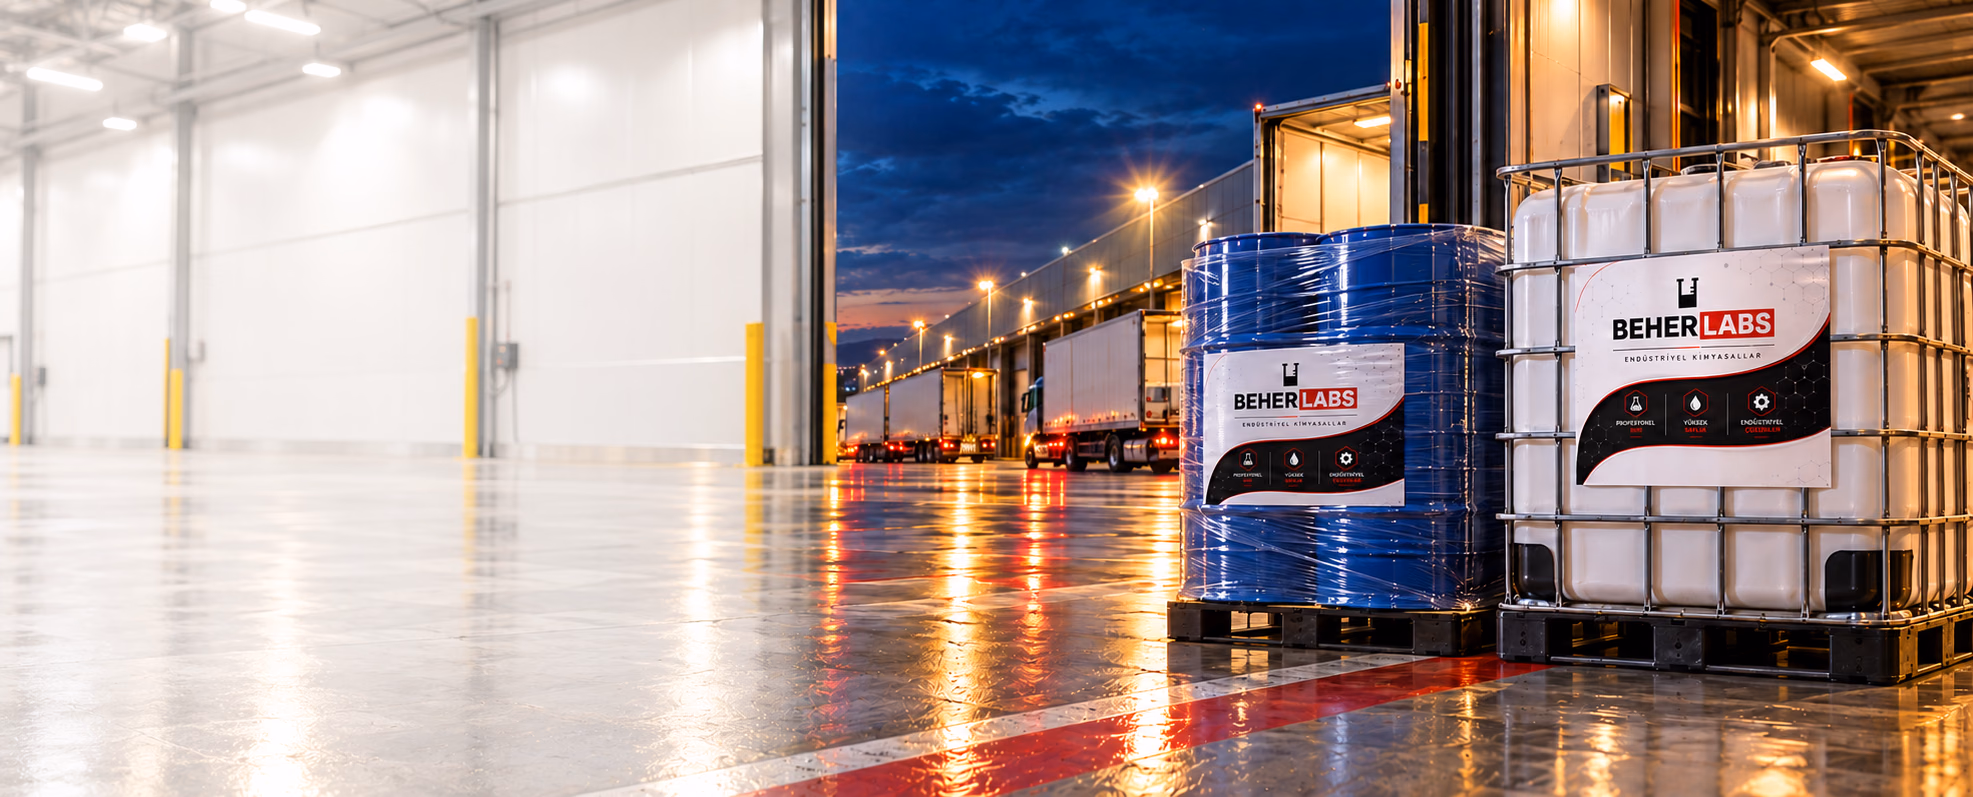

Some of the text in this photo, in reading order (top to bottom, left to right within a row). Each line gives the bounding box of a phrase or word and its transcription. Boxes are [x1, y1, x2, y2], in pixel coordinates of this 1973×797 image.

[1612, 312, 1771, 340] BEHER LABS
[1624, 352, 1762, 363] ENDÜSTRİYEL KİMYASALLAR
[1234, 389, 1355, 410] BEHER LABS
